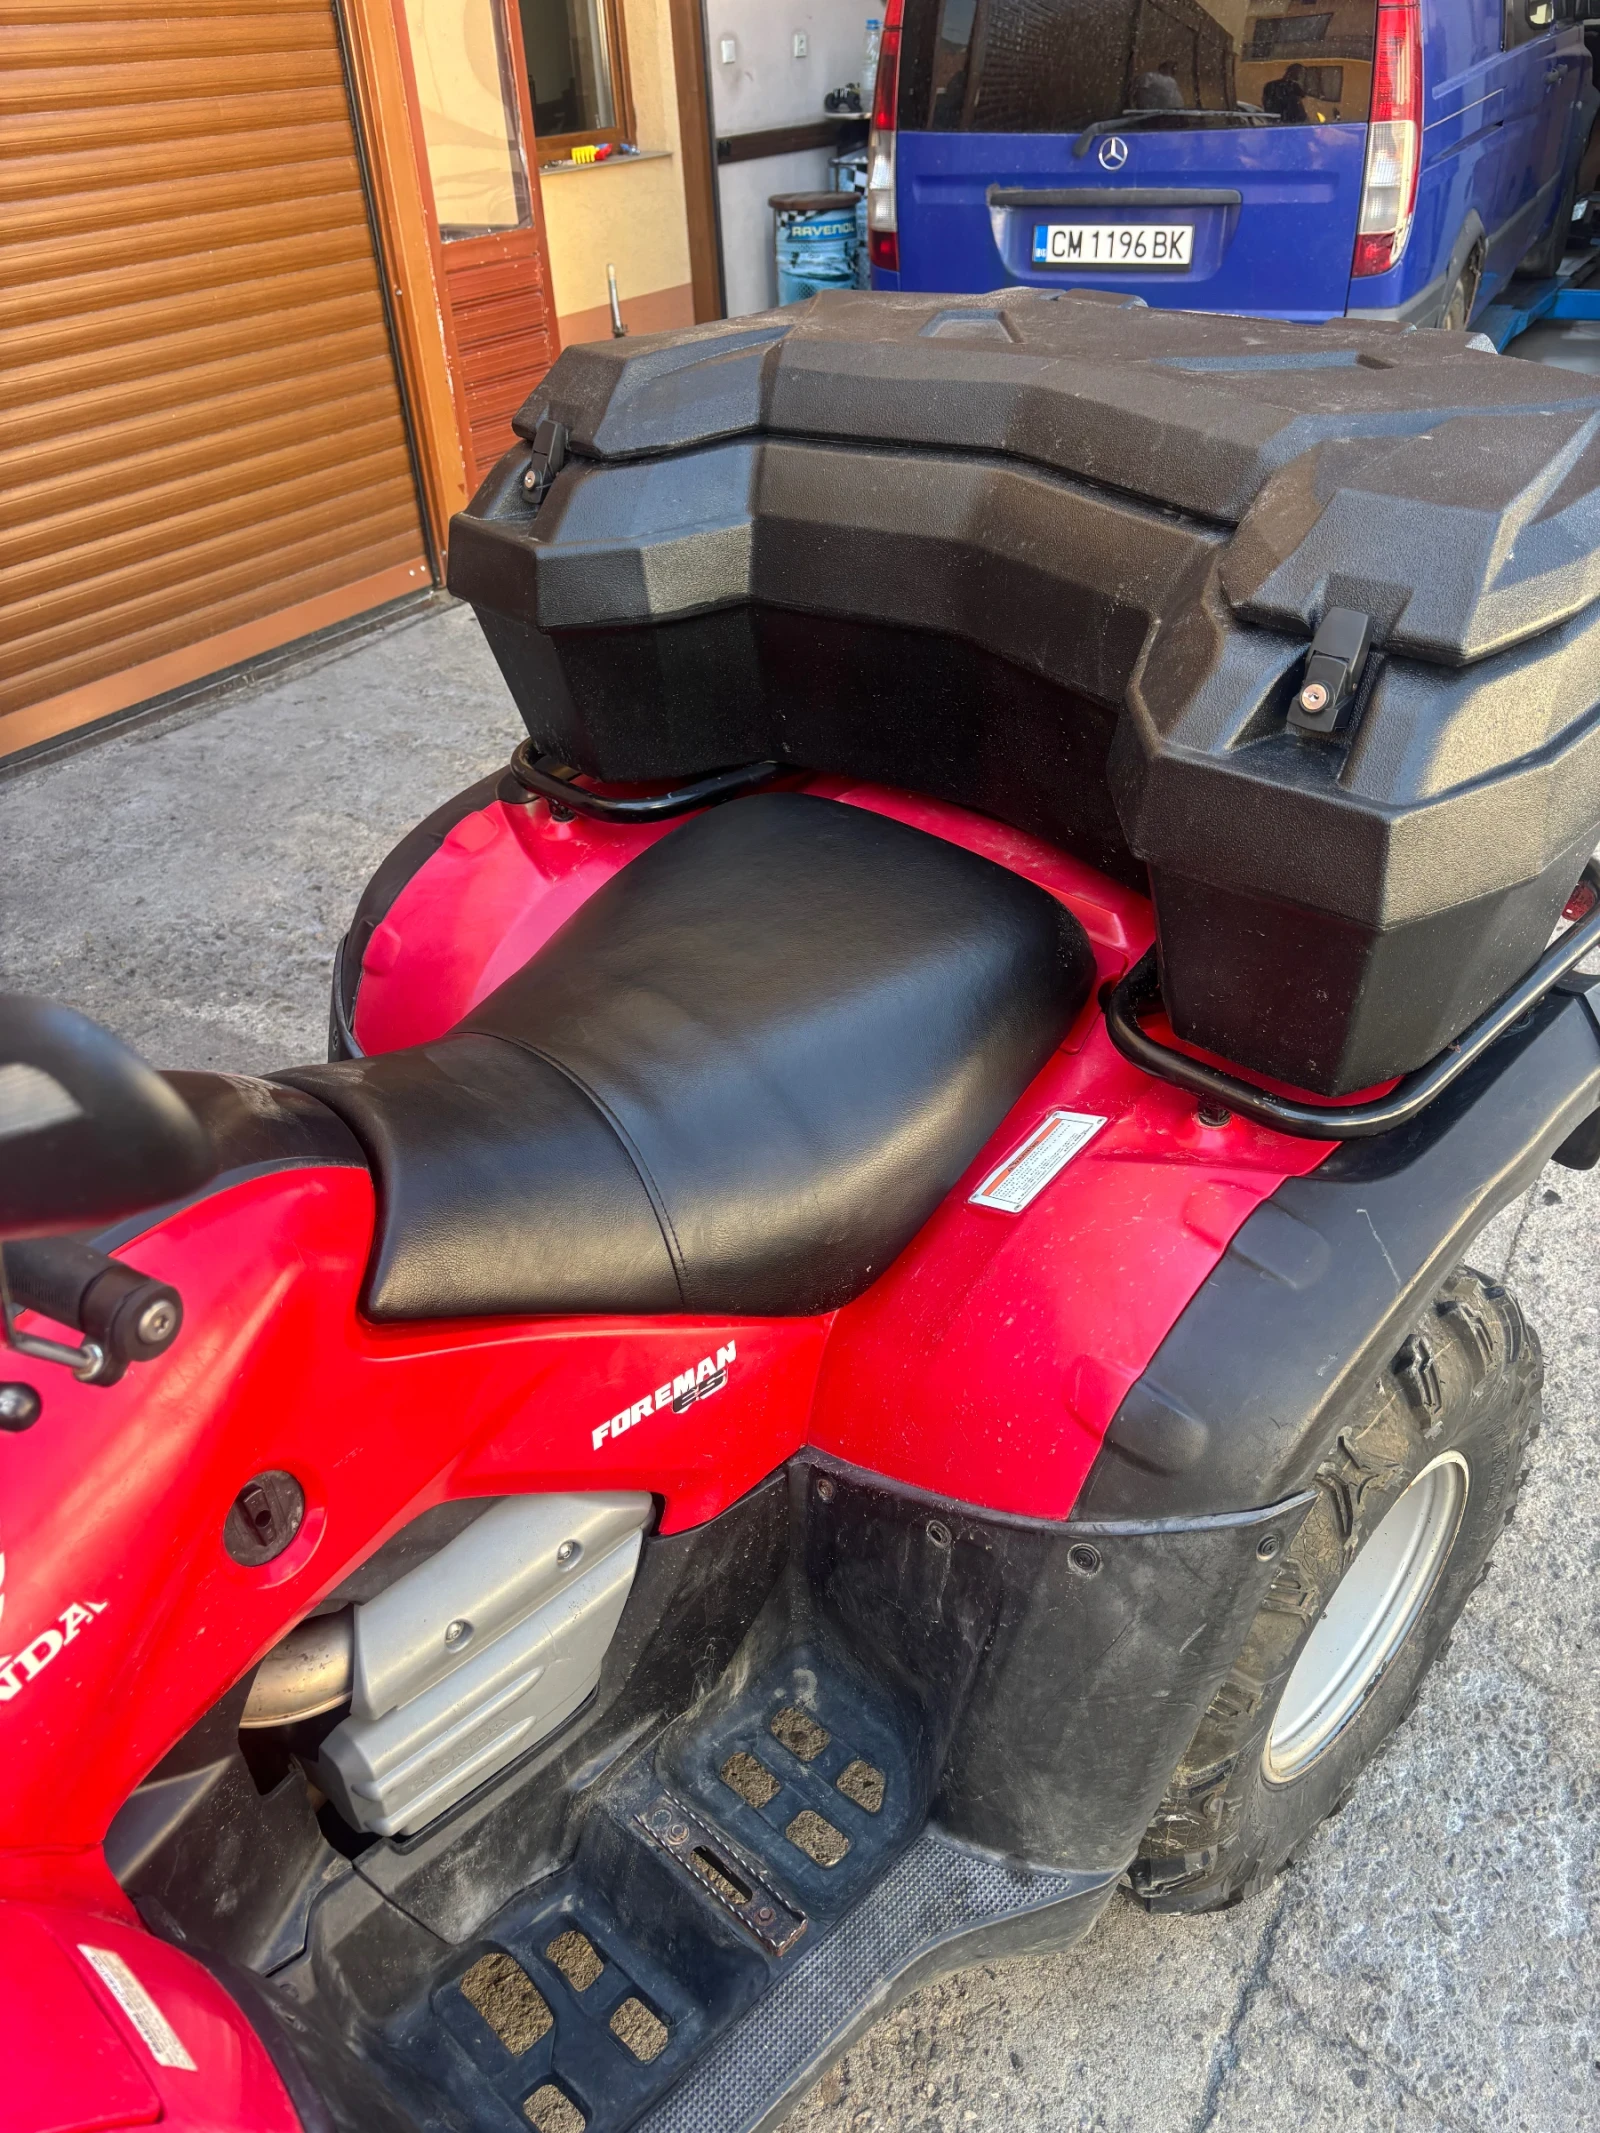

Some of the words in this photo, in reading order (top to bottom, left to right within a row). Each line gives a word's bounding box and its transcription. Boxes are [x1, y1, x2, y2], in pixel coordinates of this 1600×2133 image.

[1052, 230, 1083, 258] CM
[1092, 230, 1147, 259] 1196
[1153, 230, 1185, 259] BK
[591, 1339, 737, 1452] FOREMAN
